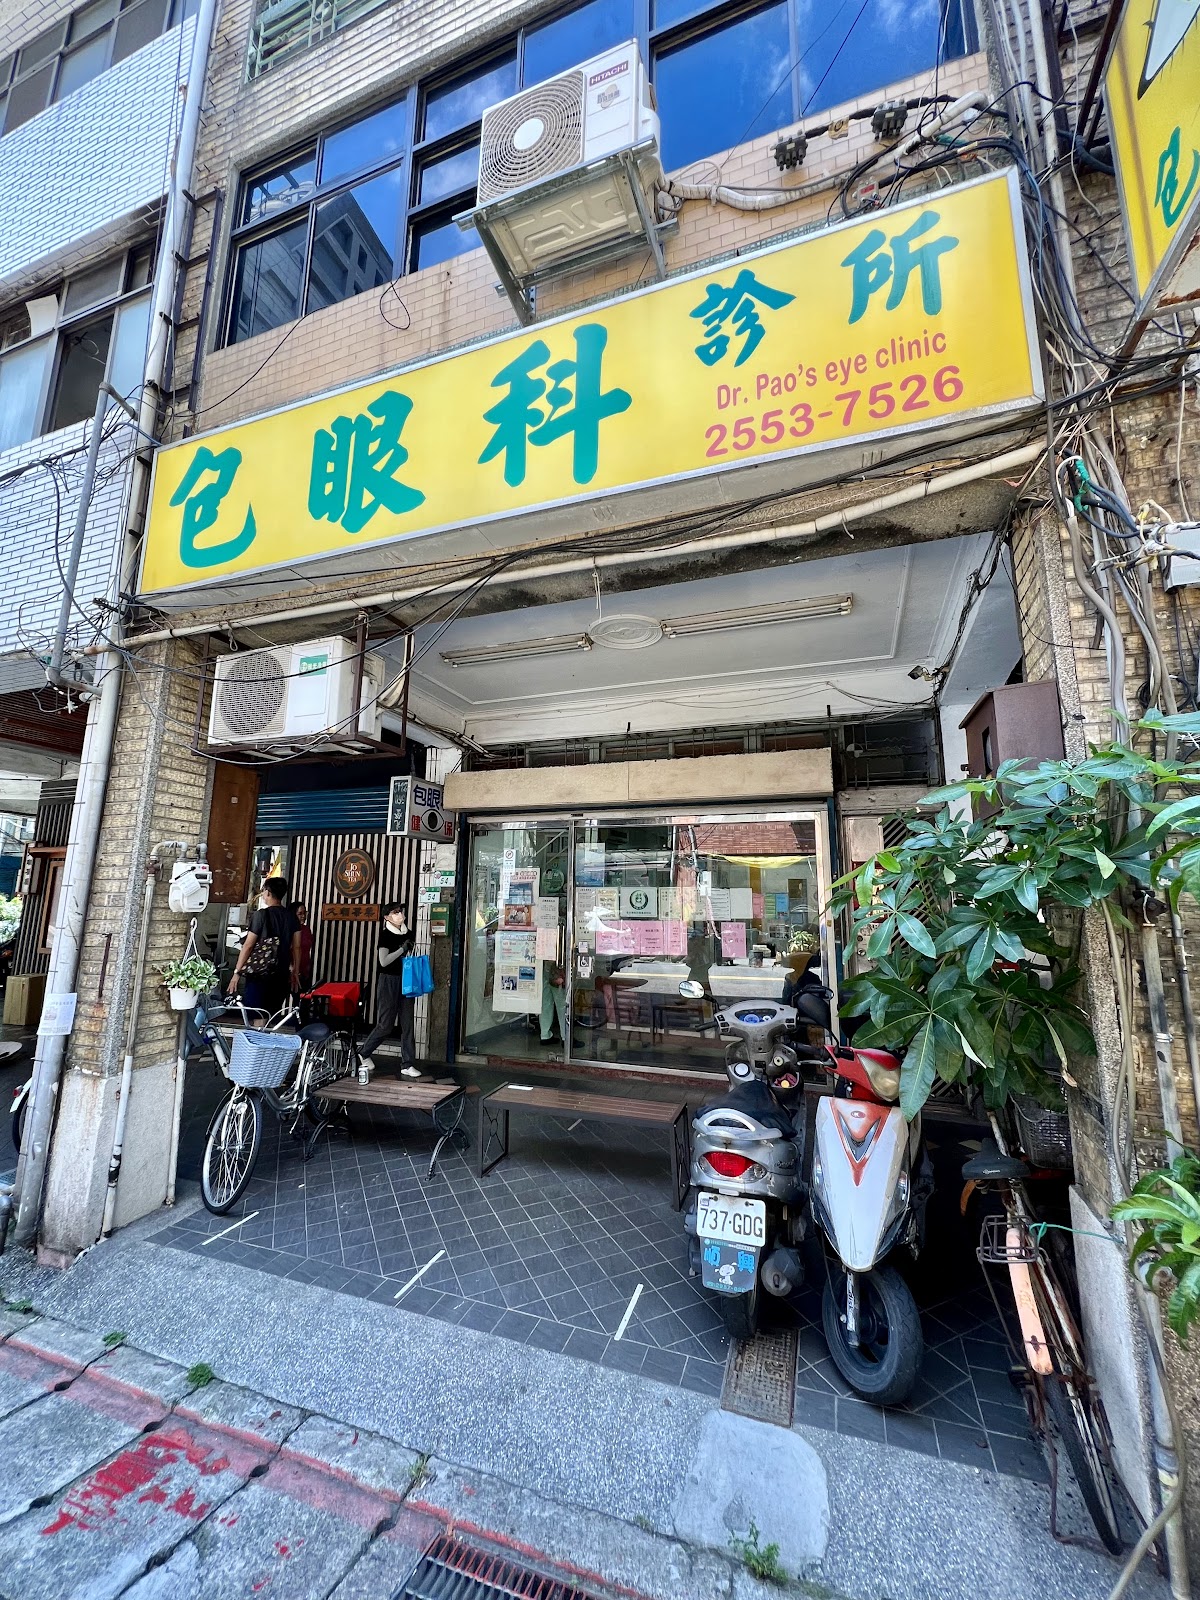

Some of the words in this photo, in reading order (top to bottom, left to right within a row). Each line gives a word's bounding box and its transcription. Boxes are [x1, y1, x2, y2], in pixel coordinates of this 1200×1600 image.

[591, 63, 627, 84] HITACHI
[717, 384, 748, 410] Dr.
[756, 363, 818, 401] Pao's
[825, 353, 867, 386] eye
[875, 329, 947, 368] clinic
[169, 210, 960, 569] 包眼科診所
[704, 365, 964, 458] 2553-7526
[413, 784, 444, 810] 包眼
[440, 877, 449, 885] 54
[427, 893, 436, 901] 54
